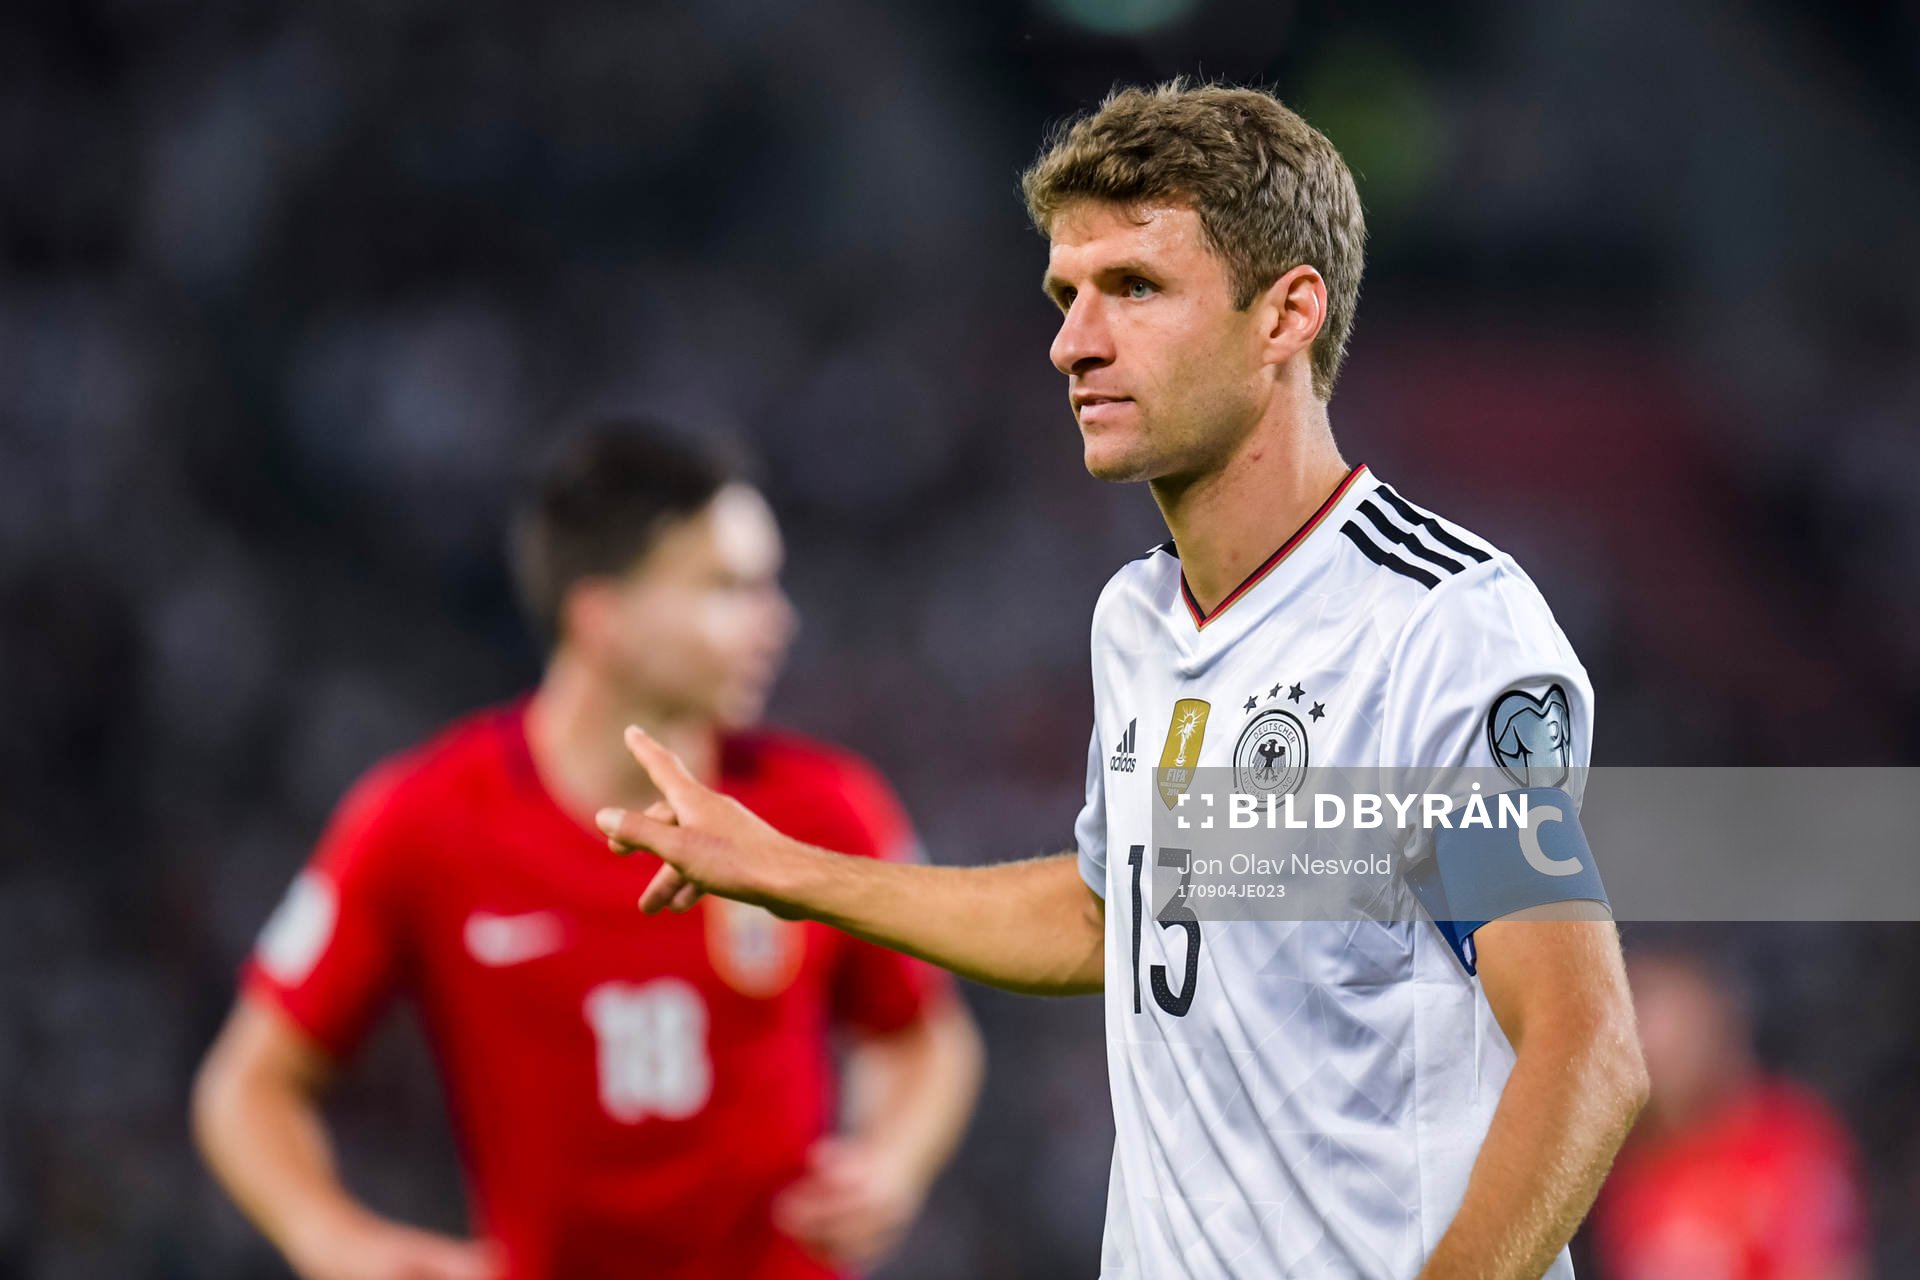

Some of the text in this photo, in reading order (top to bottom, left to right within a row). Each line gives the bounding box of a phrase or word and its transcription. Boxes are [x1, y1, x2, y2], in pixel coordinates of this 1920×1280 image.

[1253, 722, 1297, 744] DEUTSCHER
[1110, 752, 1137, 773] adidas
[1519, 804, 1584, 877] C
[1127, 844, 1202, 1018] 13
